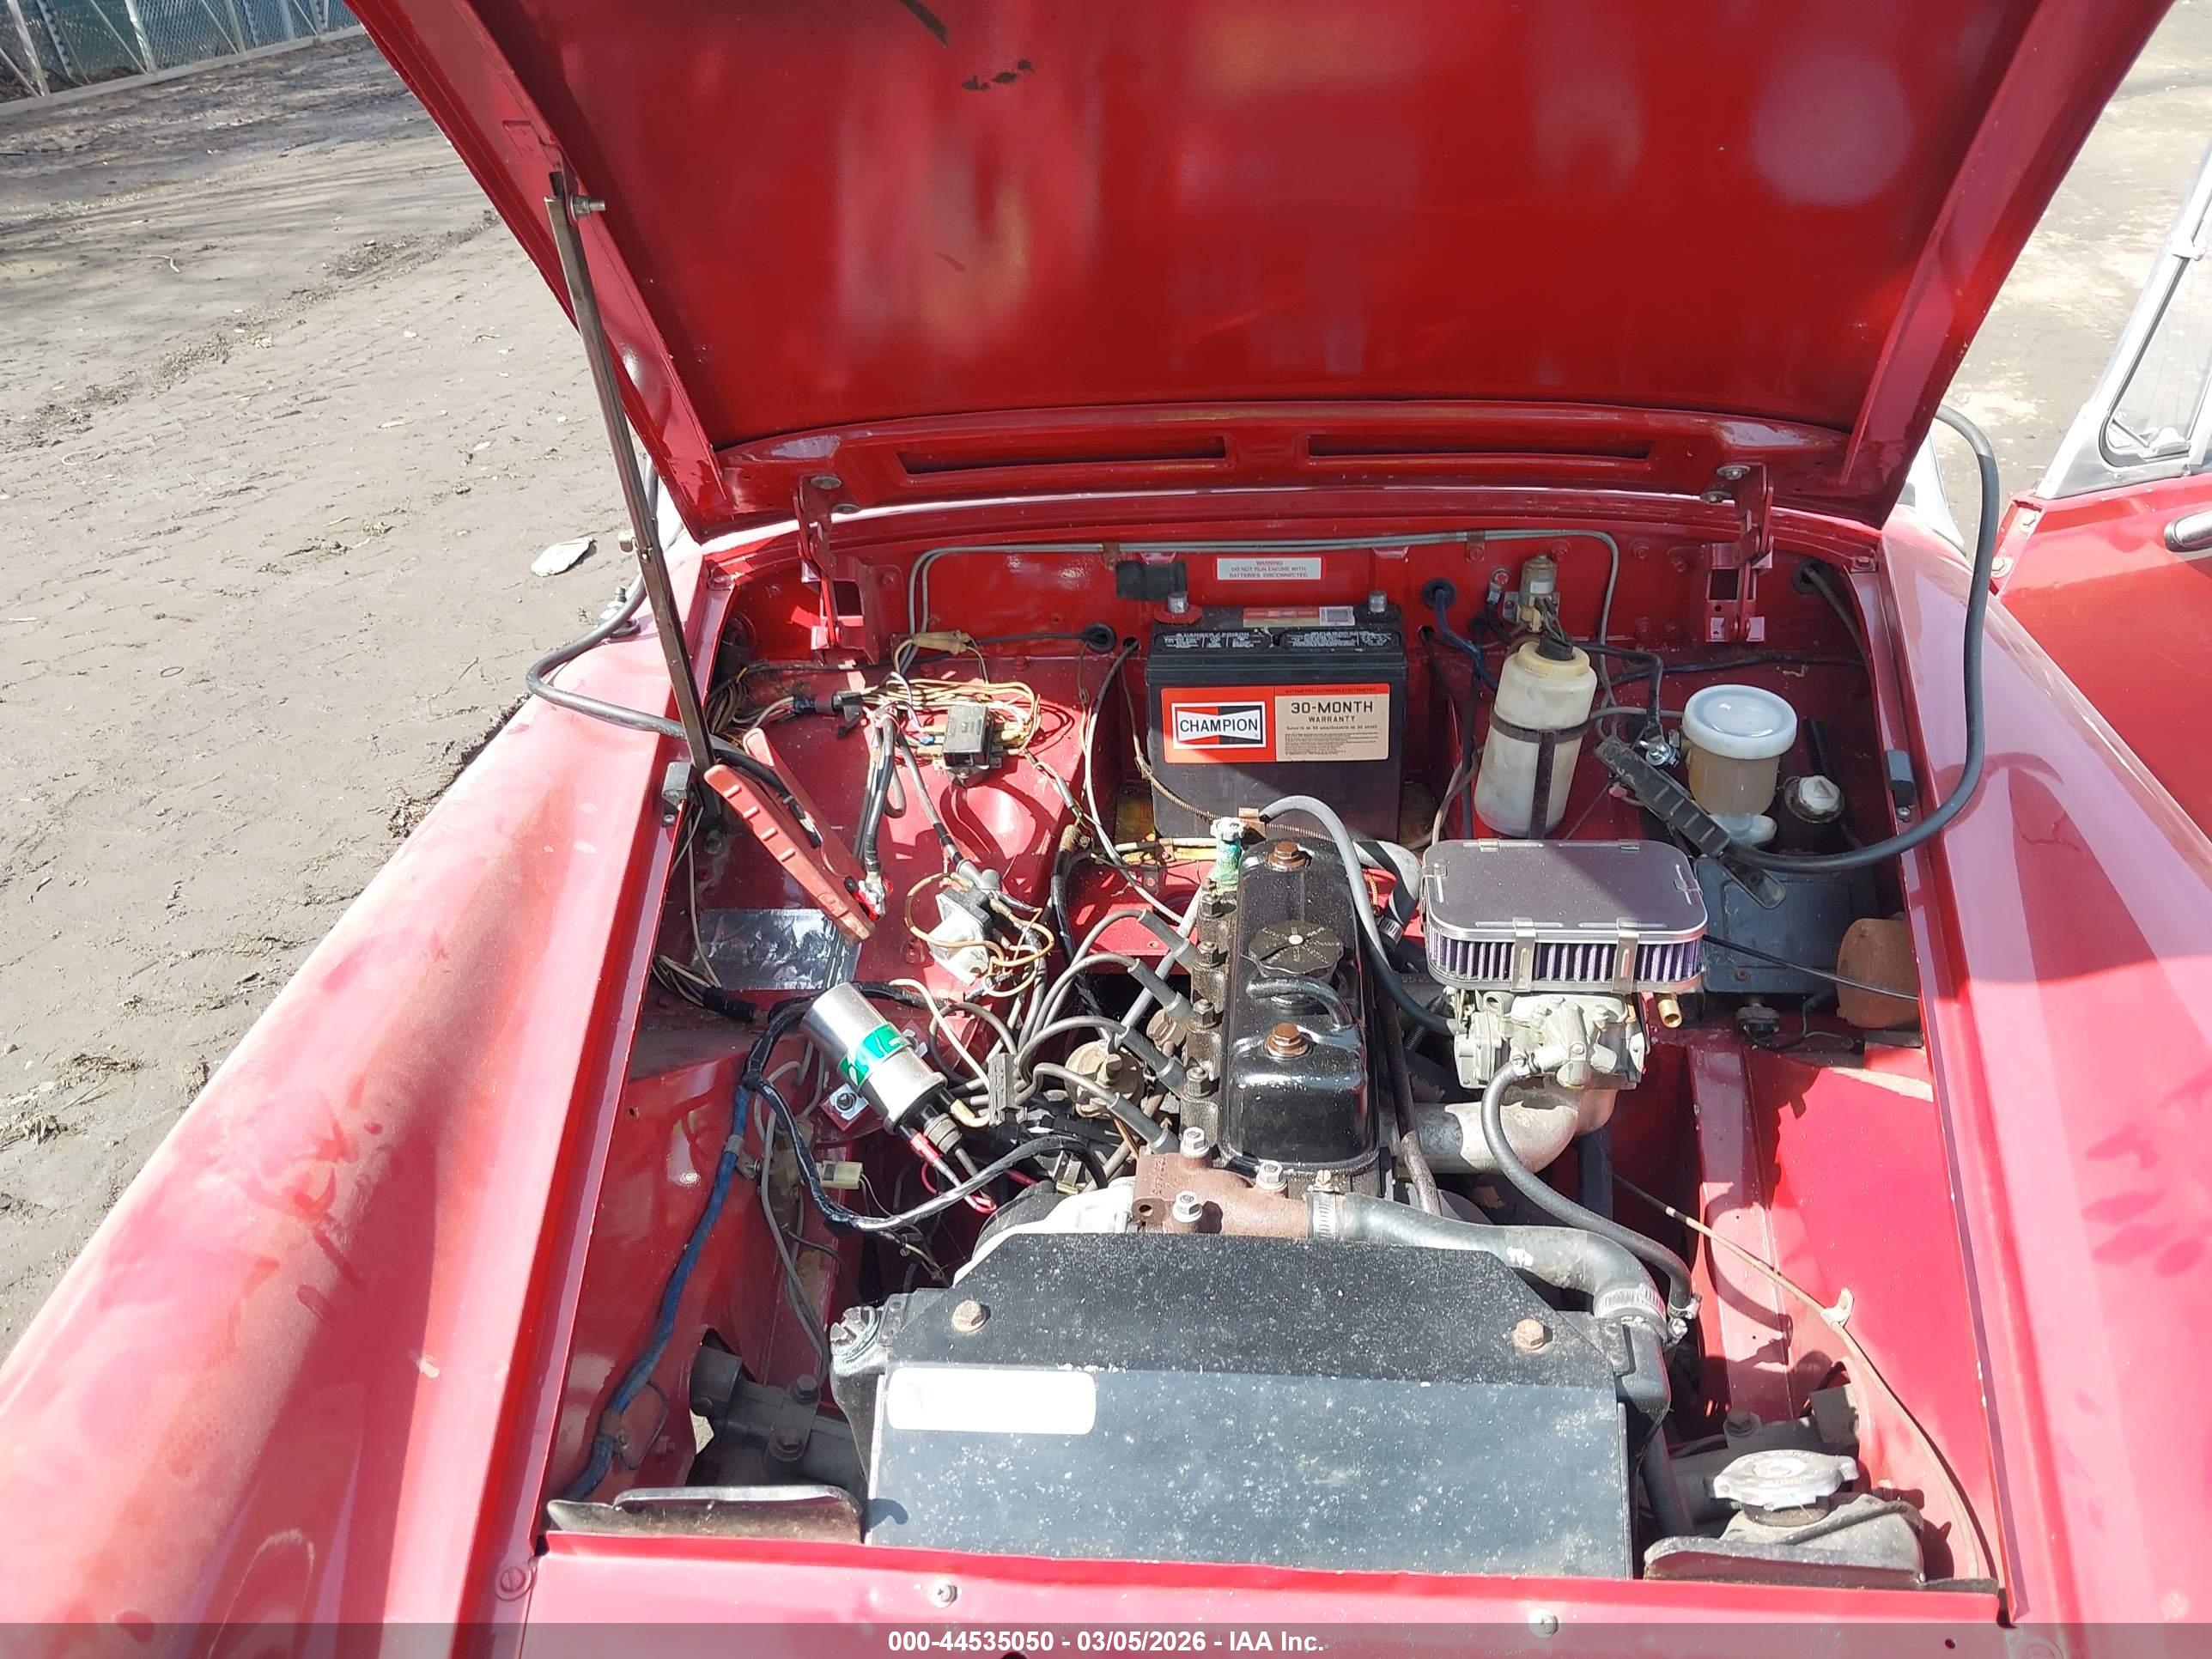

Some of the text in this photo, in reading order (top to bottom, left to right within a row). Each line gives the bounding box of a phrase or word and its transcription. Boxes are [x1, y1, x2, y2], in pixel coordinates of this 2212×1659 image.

[1291, 701, 1373, 714] 30-MONTH
[1179, 719, 1258, 732] CHAMPION
[1308, 715, 1356, 724] WARRANTY
